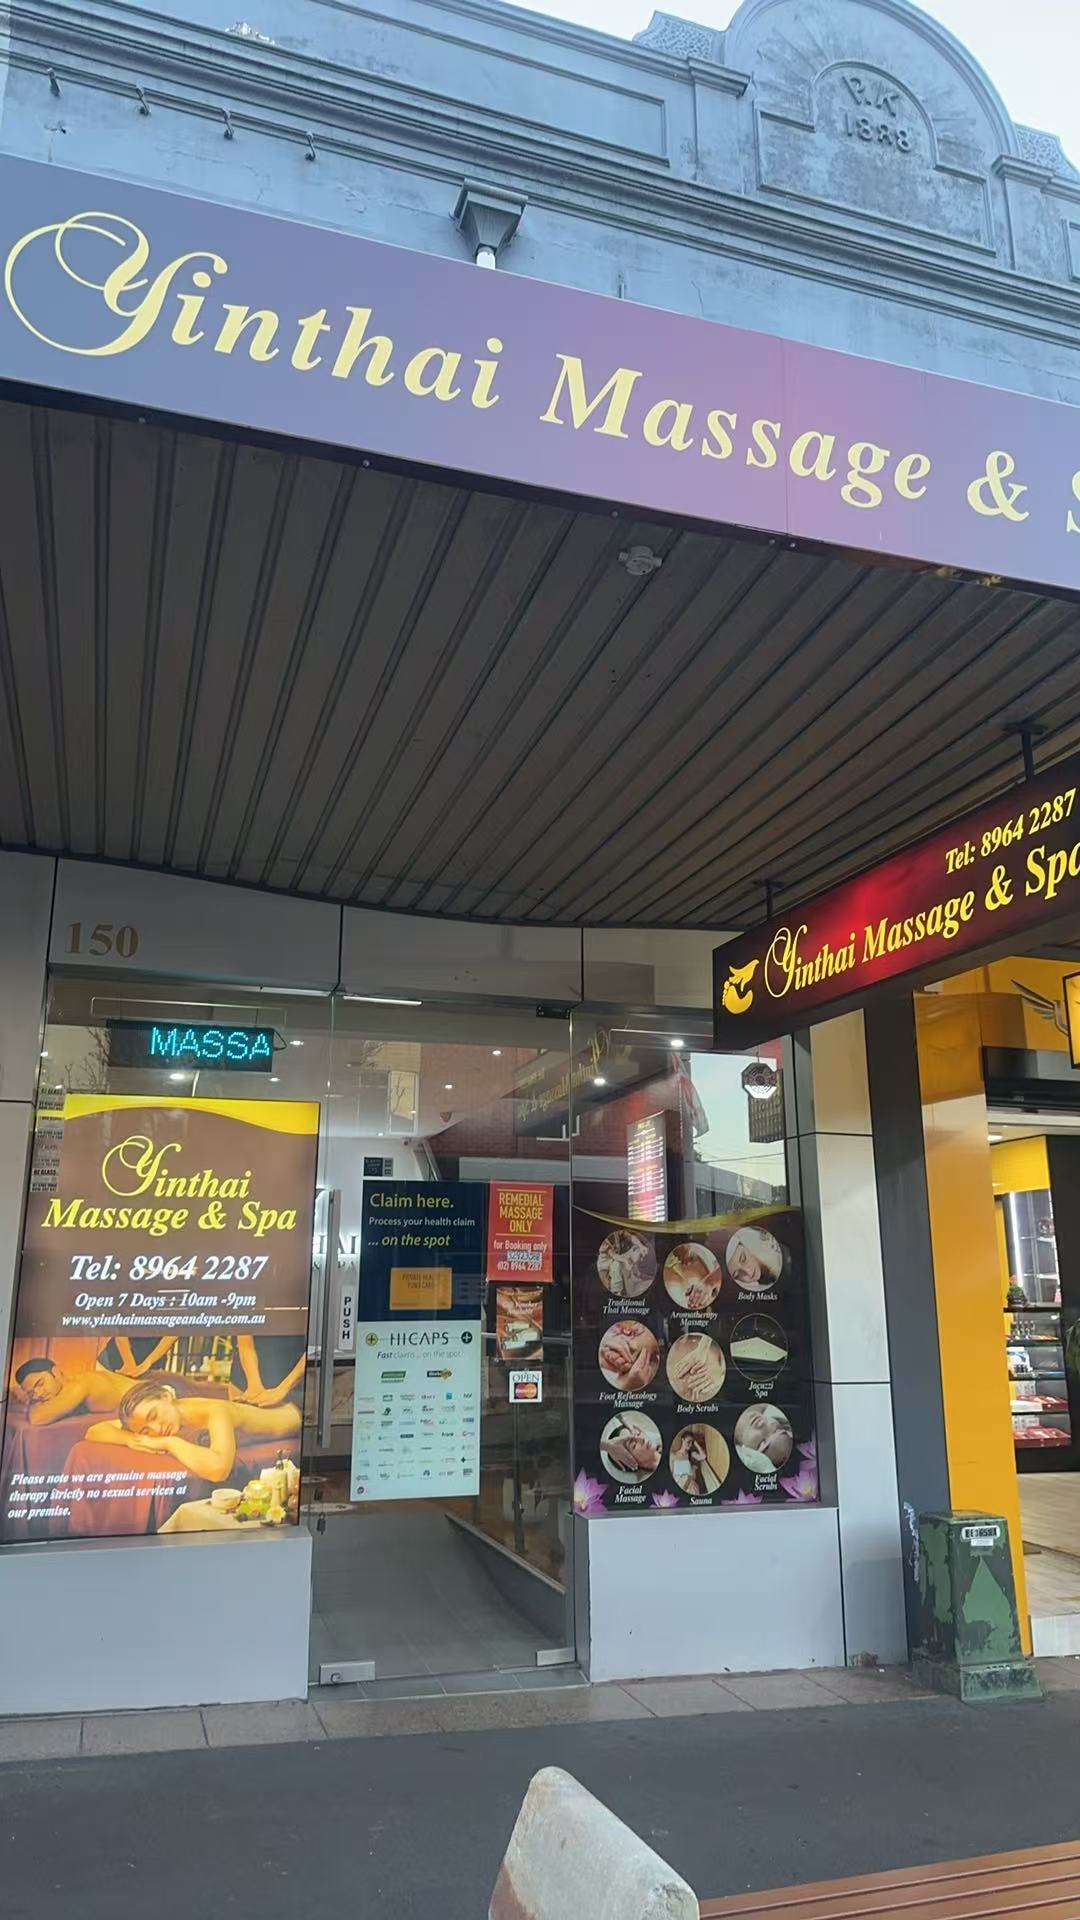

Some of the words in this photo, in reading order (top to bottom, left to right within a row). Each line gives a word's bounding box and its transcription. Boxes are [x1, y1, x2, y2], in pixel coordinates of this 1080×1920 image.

[844, 112, 911, 154] 1888
[4, 211, 504, 409] Yinthai
[539, 352, 932, 509] Massage
[966, 449, 1030, 523] &
[944, 840, 976, 875] Tel:
[980, 814, 1024, 857] 8964
[1028, 787, 1077, 835] 2287
[764, 924, 856, 998] Yinthai
[861, 889, 974, 964] Massage
[984, 864, 1014, 911] &
[65, 921, 140, 958] 150
[150, 1026, 270, 1060] MASSA
[102, 1135, 252, 1199] Yinthai
[369, 1193, 413, 1208] Claim
[416, 1193, 455, 1208] here.
[498, 1192, 544, 1207] REMEDIAL
[41, 1198, 188, 1237] Massage
[197, 1200, 226, 1230] &
[238, 1201, 297, 1237] Spa
[499, 1206, 543, 1220] MASSAGE
[368, 1216, 402, 1226] Process
[403, 1218, 422, 1228] your
[424, 1217, 451, 1226] health
[453, 1217, 476, 1227] claim
[509, 1219, 533, 1233] ONLY
[381, 1236, 398, 1246] on
[401, 1234, 421, 1246] the
[423, 1235, 451, 1249] spot
[493, 1239, 503, 1250] for
[504, 1239, 531, 1252] Booking
[533, 1240, 548, 1253] only
[69, 1255, 121, 1281] Tel:
[129, 1255, 198, 1282] 8964
[201, 1255, 269, 1281] 2287
[75, 1292, 114, 1310] Open
[118, 1292, 128, 1307] 7
[130, 1292, 166, 1310] Days
[180, 1292, 218, 1308] 10am
[607, 1298, 646, 1307] Traditional
[737, 1292, 755, 1301] Body
[756, 1292, 778, 1300] Masks
[602, 1306, 620, 1314] Thai
[620, 1306, 650, 1315] Massage
[670, 1311, 718, 1321] Aromatherapy
[62, 1313, 266, 1329] www.yinthaimassageandspa.com.au
[341, 1296, 352, 1341] PUSH
[679, 1318, 709, 1327] Massage
[390, 1331, 450, 1346] HICAPS
[377, 1351, 393, 1360] Fast
[422, 1351, 433, 1359] on
[433, 1350, 446, 1358] the
[446, 1350, 461, 1360] spot
[599, 1391, 617, 1400] Foot
[617, 1391, 657, 1402] Reflexology
[755, 1389, 769, 1398] Spa
[613, 1400, 644, 1409] Massage
[676, 1404, 695, 1414] Body
[696, 1404, 719, 1413] Scrubs
[11, 1473, 44, 1486] Please
[46, 1472, 69, 1484] note
[71, 1473, 84, 1483] we
[86, 1472, 102, 1482] are
[104, 1470, 144, 1484] genuine
[146, 1470, 188, 1481] massage
[754, 1474, 777, 1483] Facial
[619, 1485, 642, 1494] Facial
[754, 1482, 778, 1491] Scrubs
[9, 1490, 48, 1503] therapy
[86, 1490, 100, 1498] no
[102, 1486, 134, 1498] sexual
[136, 1485, 174, 1497] services
[176, 1485, 187, 1495] at
[614, 1493, 647, 1503] Massage
[689, 1497, 713, 1506] Sauna
[7, 1508, 28, 1519] our
[28, 1506, 72, 1520] premise.
